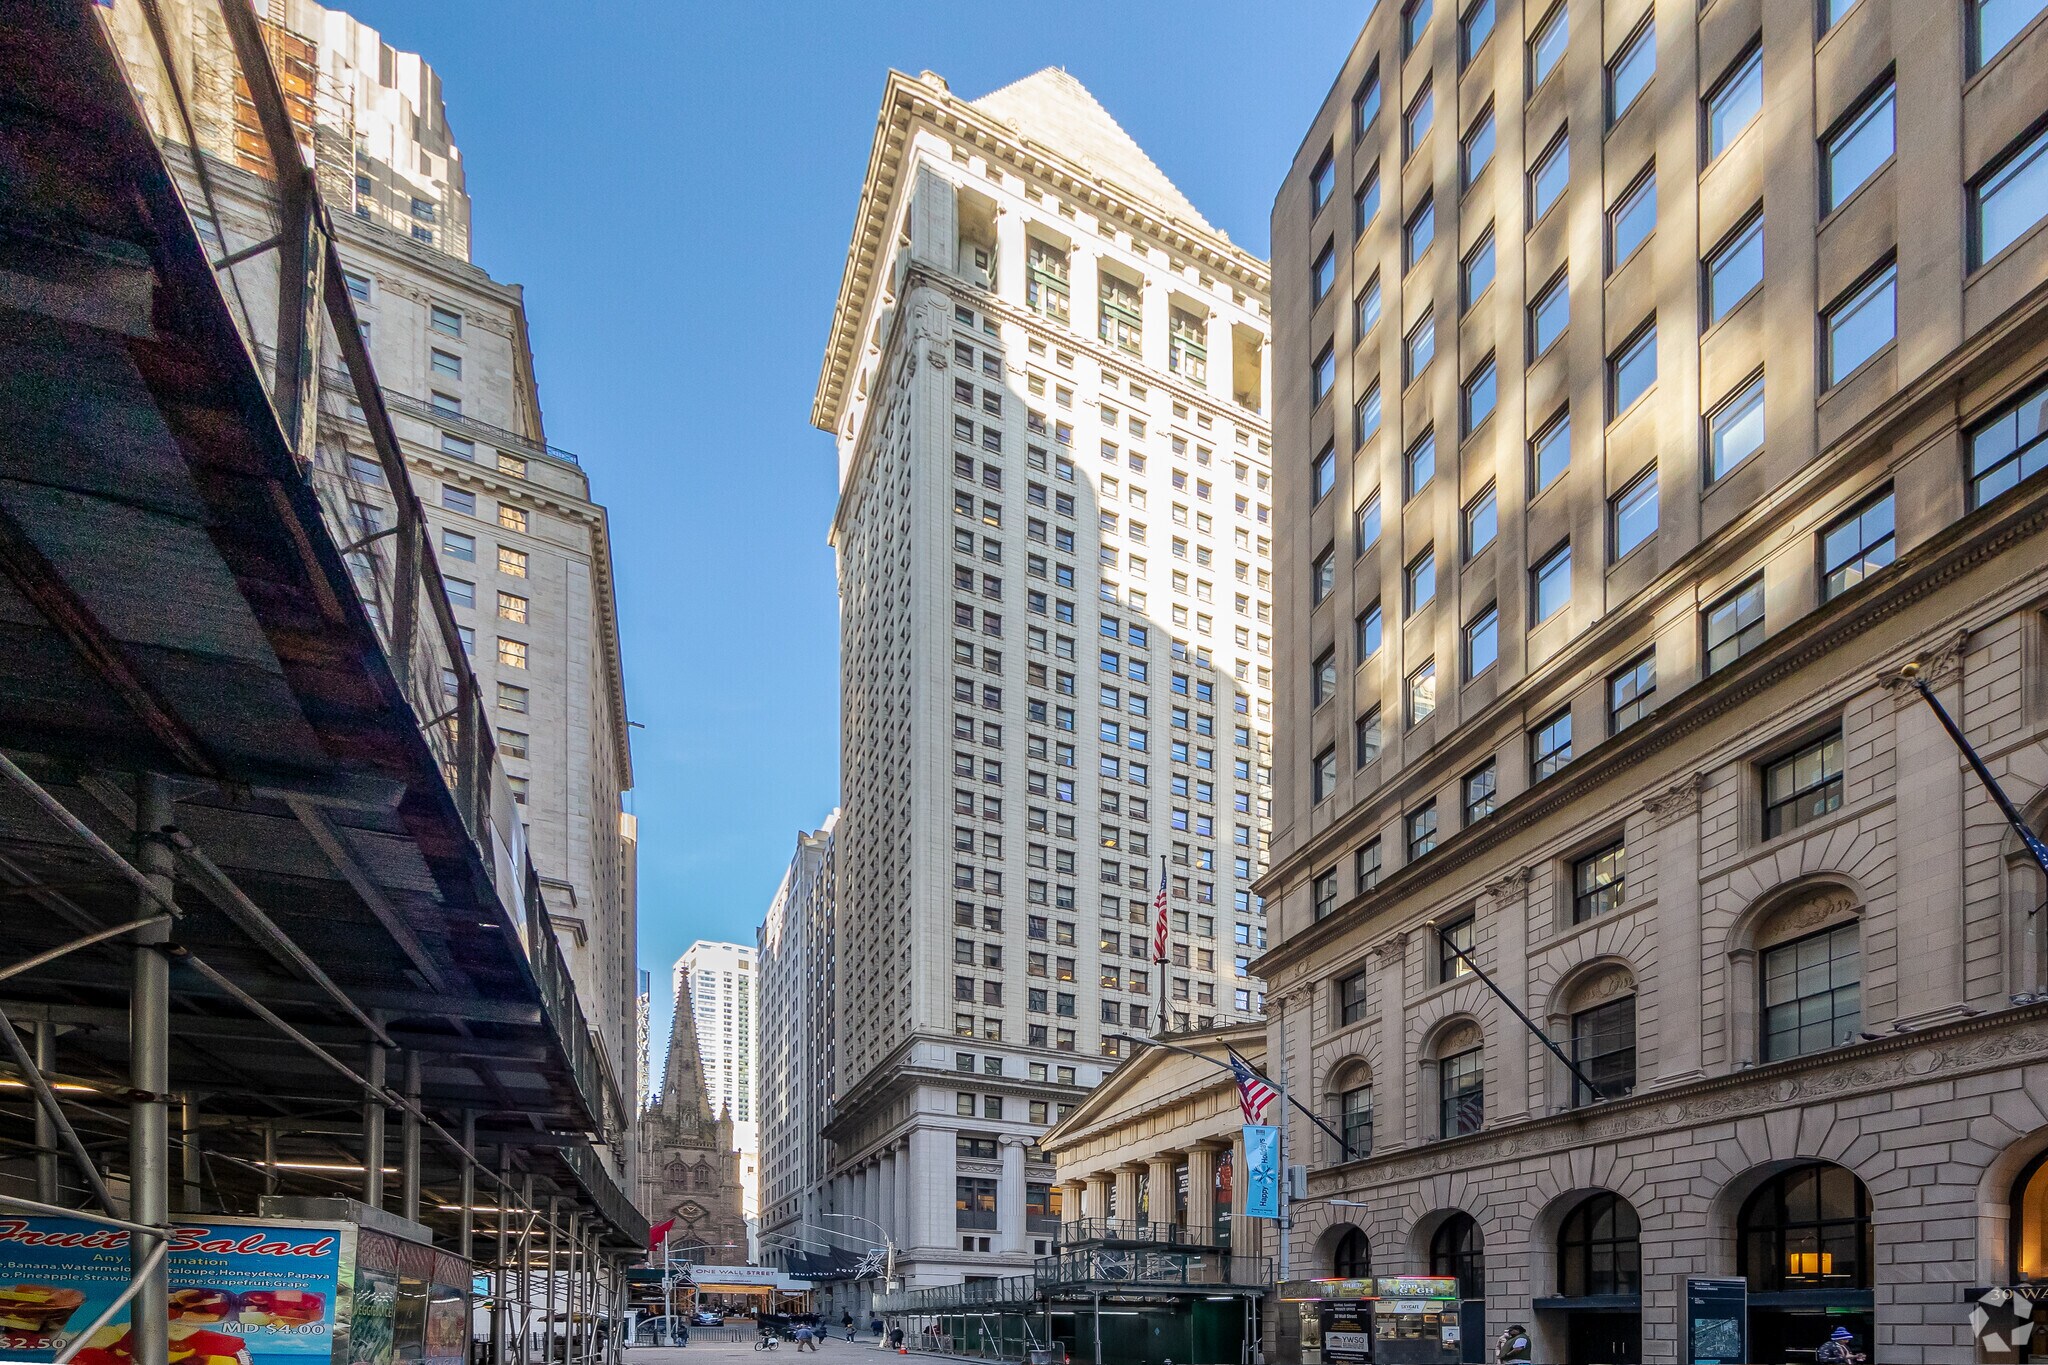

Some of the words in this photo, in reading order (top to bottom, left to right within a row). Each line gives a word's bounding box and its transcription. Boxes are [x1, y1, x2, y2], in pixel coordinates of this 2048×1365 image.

[1260, 1138, 1268, 1164] Holidays
[1260, 1186, 1269, 1207] Happy
[167, 1228, 335, 1257] Salad
[93, 1253, 124, 1263] Any
[1990, 1288, 2014, 1300] 30
[222, 1322, 260, 1334] MD
[265, 1322, 325, 1335] $4.00
[0, 1336, 67, 1349] $2.50
[1342, 1336, 1365, 1344] YWSO
